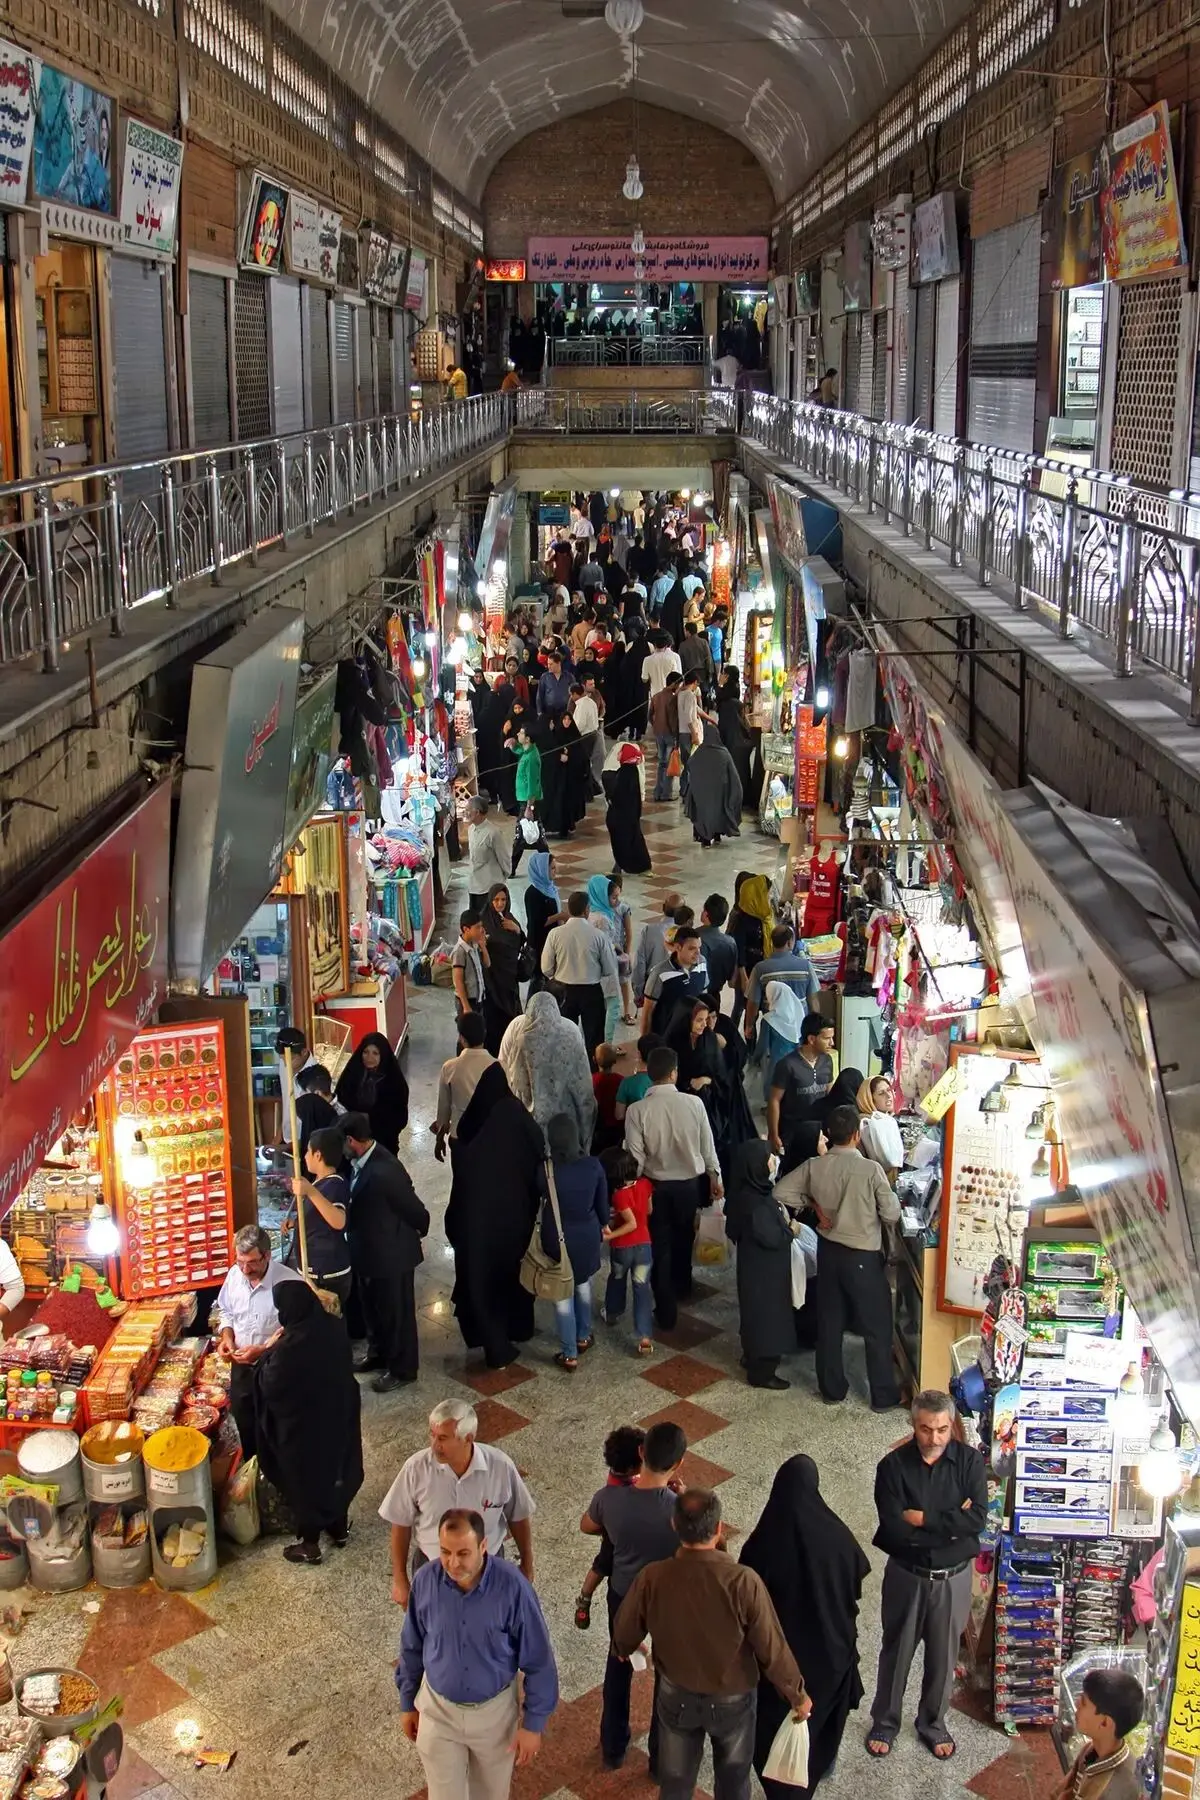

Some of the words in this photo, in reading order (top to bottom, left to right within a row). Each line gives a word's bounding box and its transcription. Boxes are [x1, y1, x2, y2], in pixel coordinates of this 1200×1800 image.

[674, 240, 710, 250] فروشگاه
[745, 253, 760, 271] مرکز
[106, 850, 161, 1009] زعفران
[102, 1035, 117, 1067] پلاک
